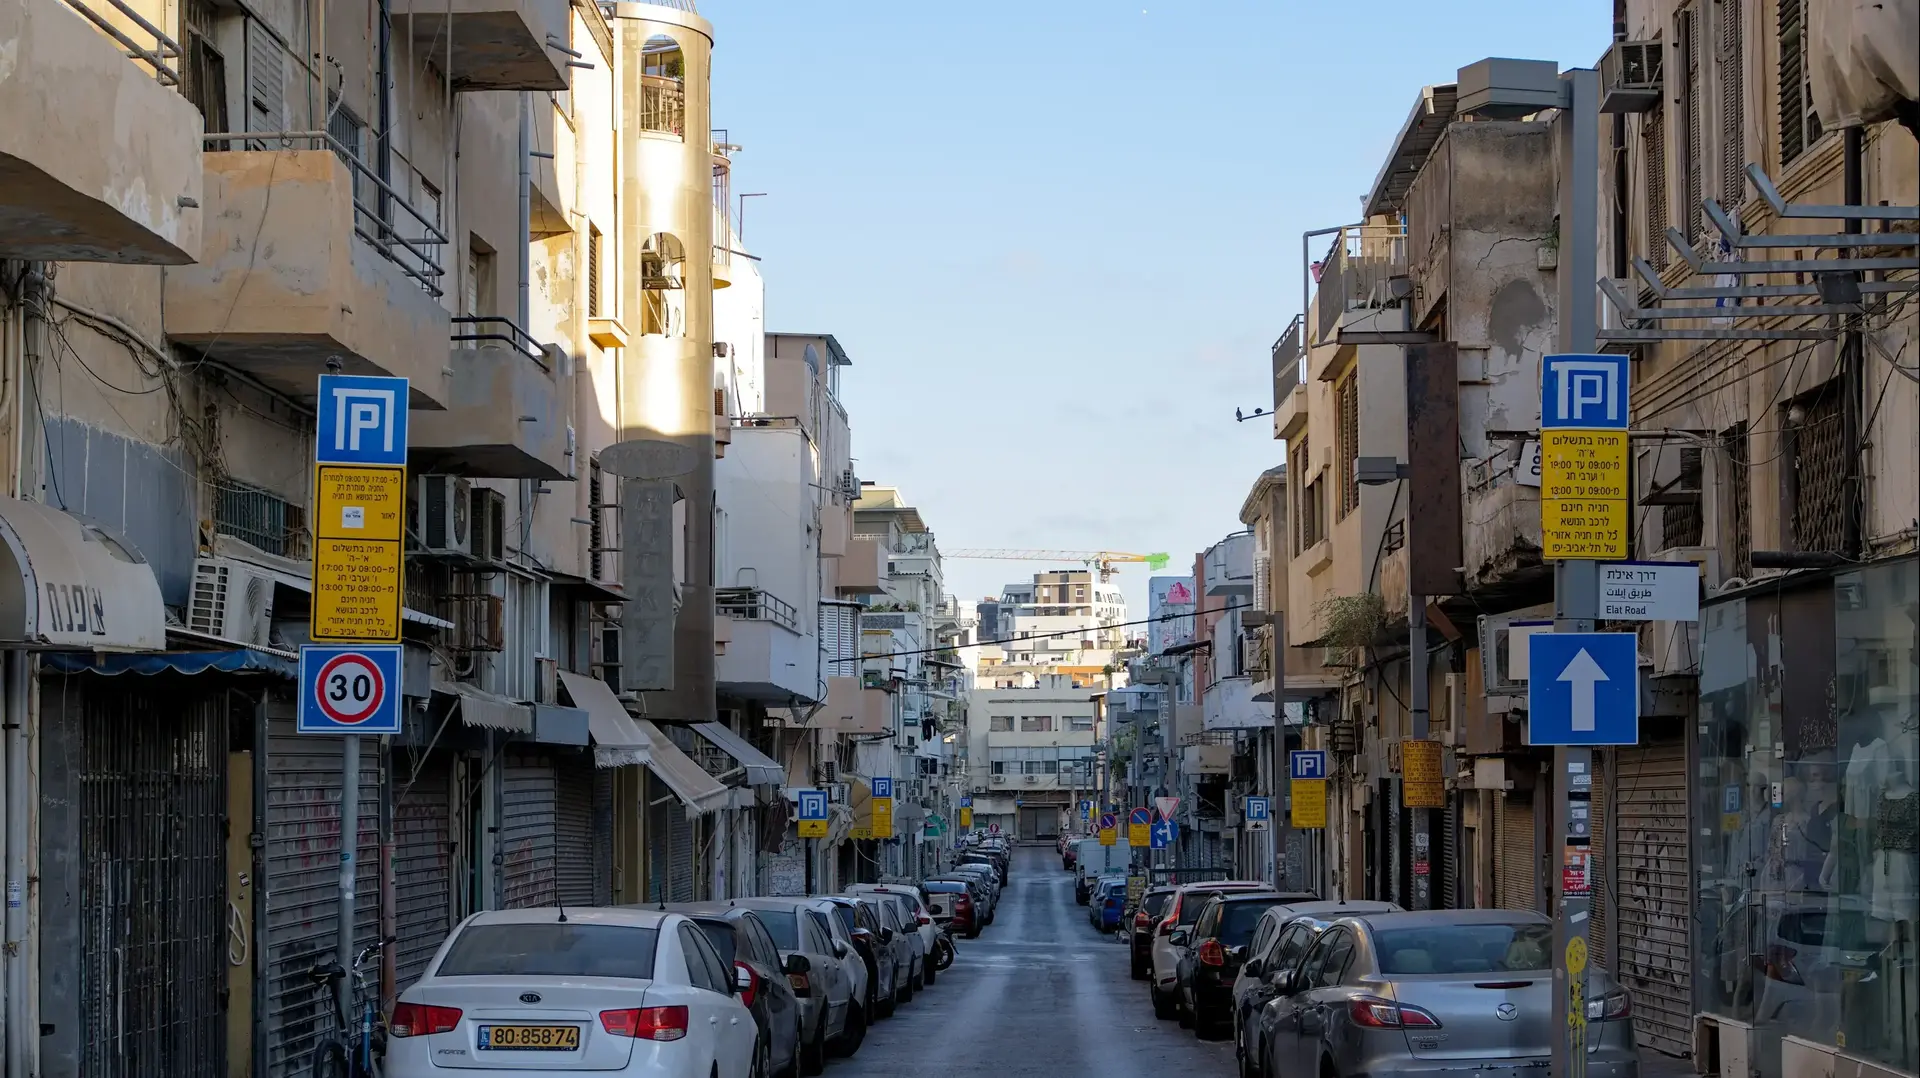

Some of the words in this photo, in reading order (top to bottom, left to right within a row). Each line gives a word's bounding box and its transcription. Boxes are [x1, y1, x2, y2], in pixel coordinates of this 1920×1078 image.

[1553, 435, 1592, 445] בתשלום
[1597, 437, 1619, 446] חניה
[1550, 460, 1571, 469] 19:00
[1575, 461, 1585, 469] עד
[1566, 472, 1575, 480] חג
[1579, 472, 1598, 482] וערבי
[337, 484, 344, 492] רק
[1551, 486, 1571, 495] 13:00
[1575, 486, 1585, 495] עד
[374, 493, 388, 501] לרכב
[1561, 504, 1583, 512] חינם
[1588, 504, 1609, 512] חניה
[1561, 518, 1585, 526] הנושא
[1589, 516, 1609, 526] לרכב
[1551, 531, 1570, 539] אזורי
[1575, 531, 1592, 539] חניה
[1595, 532, 1603, 540] תו
[1607, 530, 1617, 540] כל
[333, 544, 364, 553] בתשלום
[1604, 543, 1616, 553] של
[1607, 569, 1633, 579] אילת
[1637, 572, 1656, 582] דרך
[1628, 588, 1651, 599] طريق
[359, 596, 375, 604] חניה
[360, 606, 378, 614] לרכב
[1606, 606, 1622, 614] Elat
[1625, 606, 1646, 614] Road
[376, 617, 385, 625] כל
[380, 628, 390, 636] של
[330, 675, 370, 701] 30
